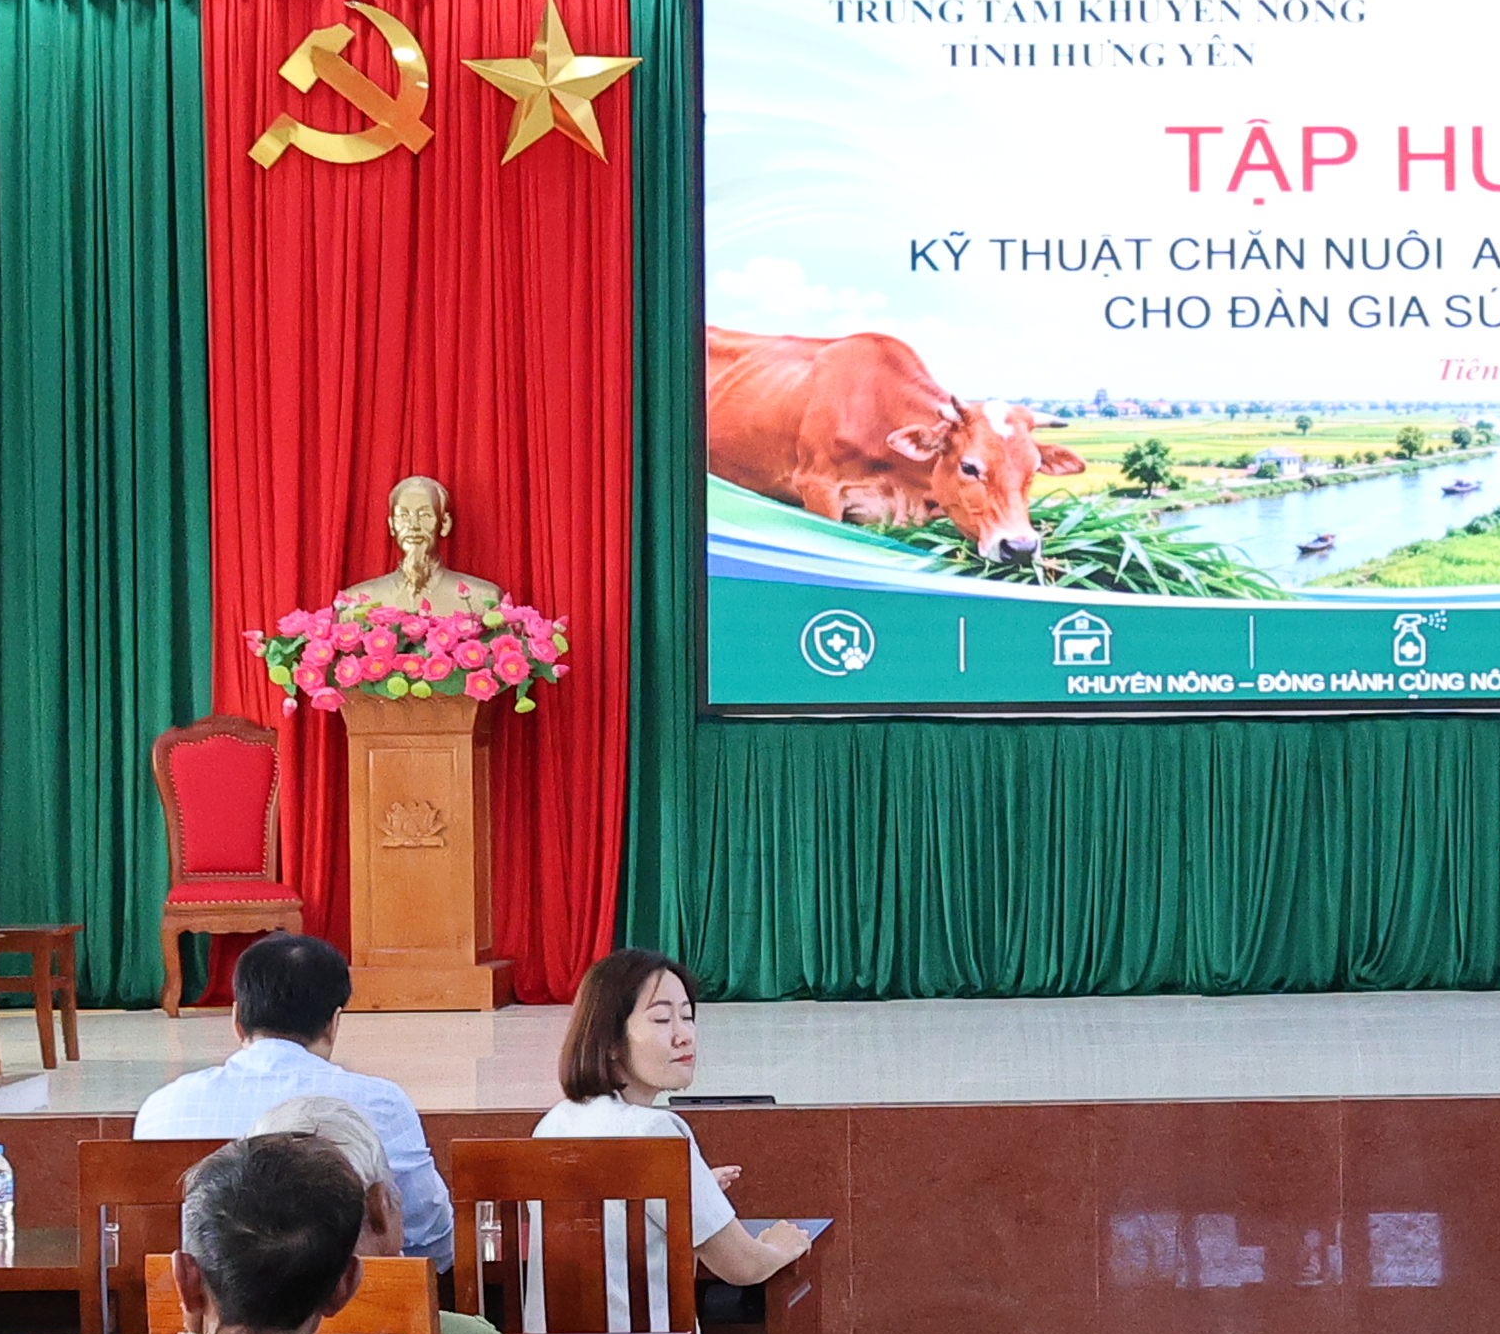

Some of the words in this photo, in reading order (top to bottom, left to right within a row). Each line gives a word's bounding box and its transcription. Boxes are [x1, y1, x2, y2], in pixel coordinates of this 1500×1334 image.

[828, 0, 965, 24] TRUNG
[1052, 38, 1166, 68] HƯNG
[1177, 33, 1257, 68] YÊN
[1164, 117, 1358, 206] TẬP
[910, 231, 972, 272] KỸ
[989, 234, 1153, 278] THUẬT
[1168, 230, 1306, 271] CHĂN
[1325, 230, 1443, 271] NUÔI
[1104, 295, 1211, 330] CHO
[1227, 288, 1329, 329] ĐÀN
[1348, 295, 1430, 329] GIA
[1438, 356, 1500, 382] Tiên
